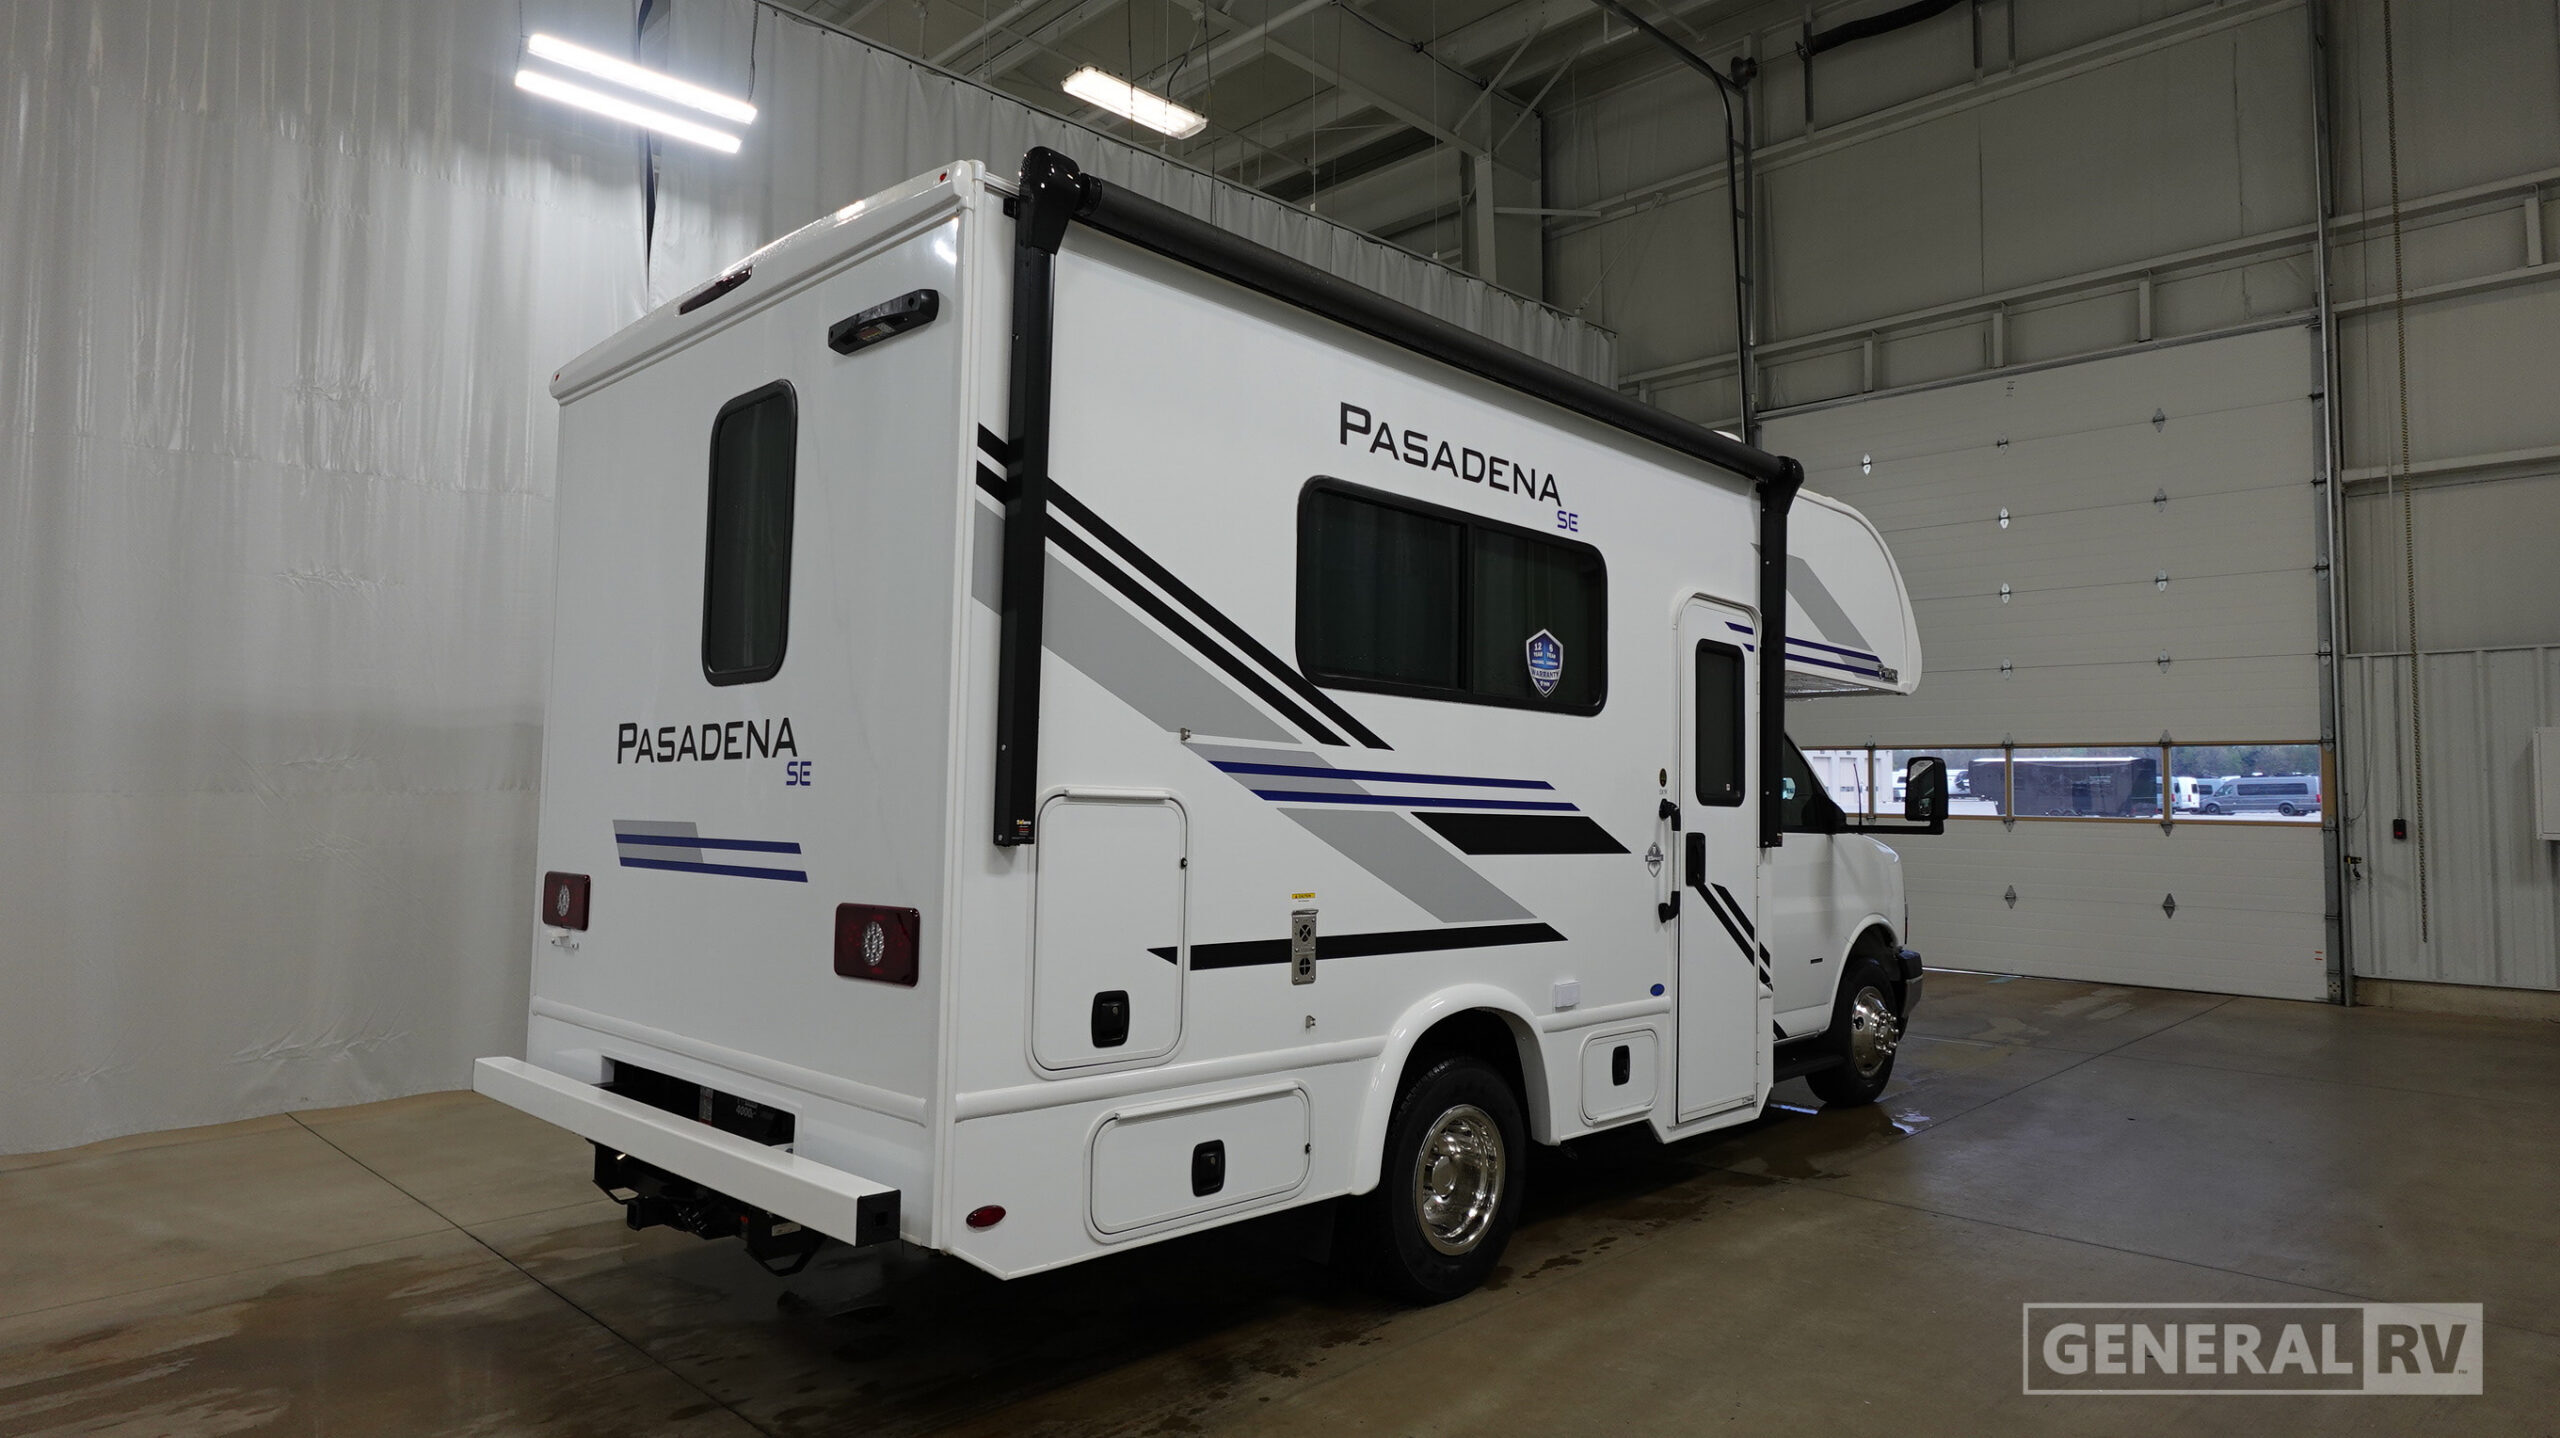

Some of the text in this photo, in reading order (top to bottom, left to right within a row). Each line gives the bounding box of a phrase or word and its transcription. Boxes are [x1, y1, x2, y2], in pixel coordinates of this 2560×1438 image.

[1339, 402, 1562, 507] PASADENA
[1556, 510, 1579, 533] SE
[1534, 643, 1542, 651] 12
[1531, 669, 1559, 679] WARRANTY
[617, 717, 798, 764] PASADENA
[785, 761, 812, 787] SE
